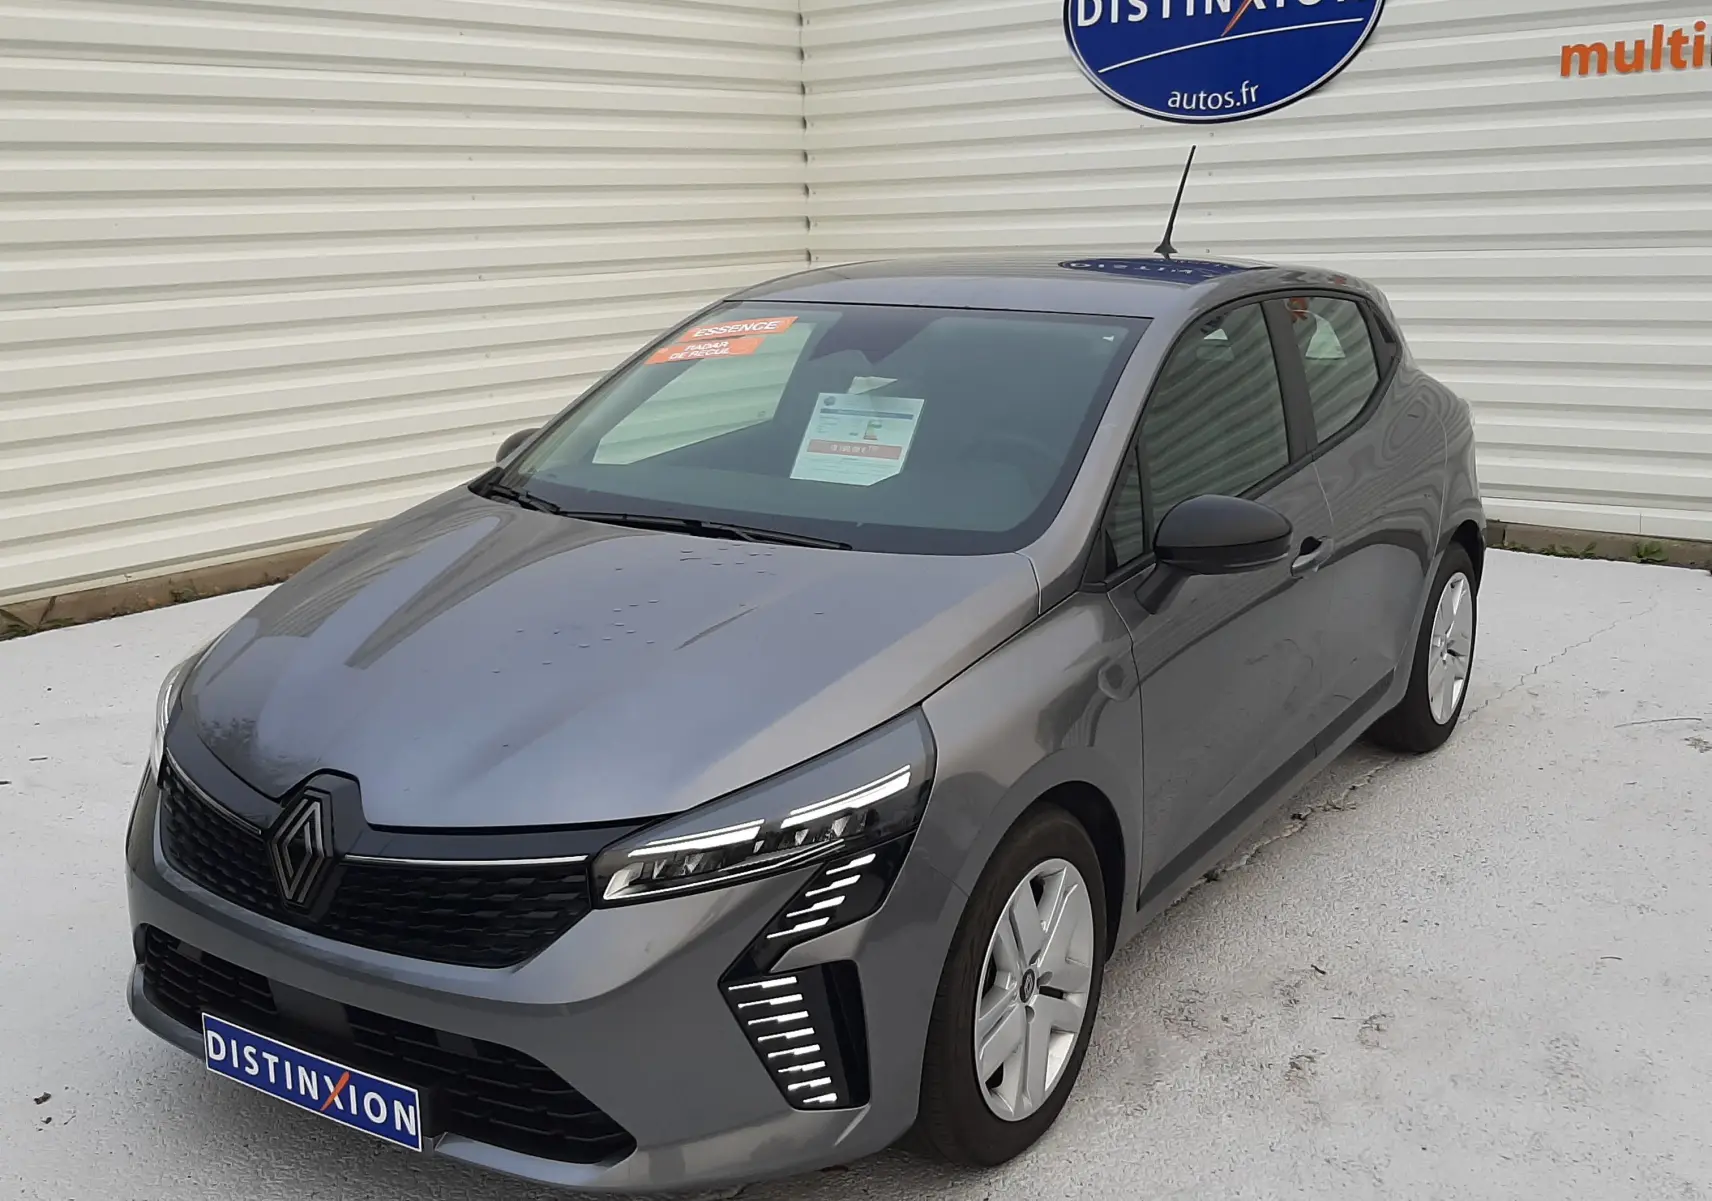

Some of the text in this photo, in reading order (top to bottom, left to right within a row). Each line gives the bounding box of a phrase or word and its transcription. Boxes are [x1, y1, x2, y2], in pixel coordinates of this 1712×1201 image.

[1560, 20, 1712, 77] multi
[1168, 81, 1260, 110] autos.fr
[693, 320, 781, 337] ESSENCE
[669, 347, 729, 360] DE RECUL
[685, 341, 729, 351] RADAR
[207, 1030, 416, 1136] DISTINXION
